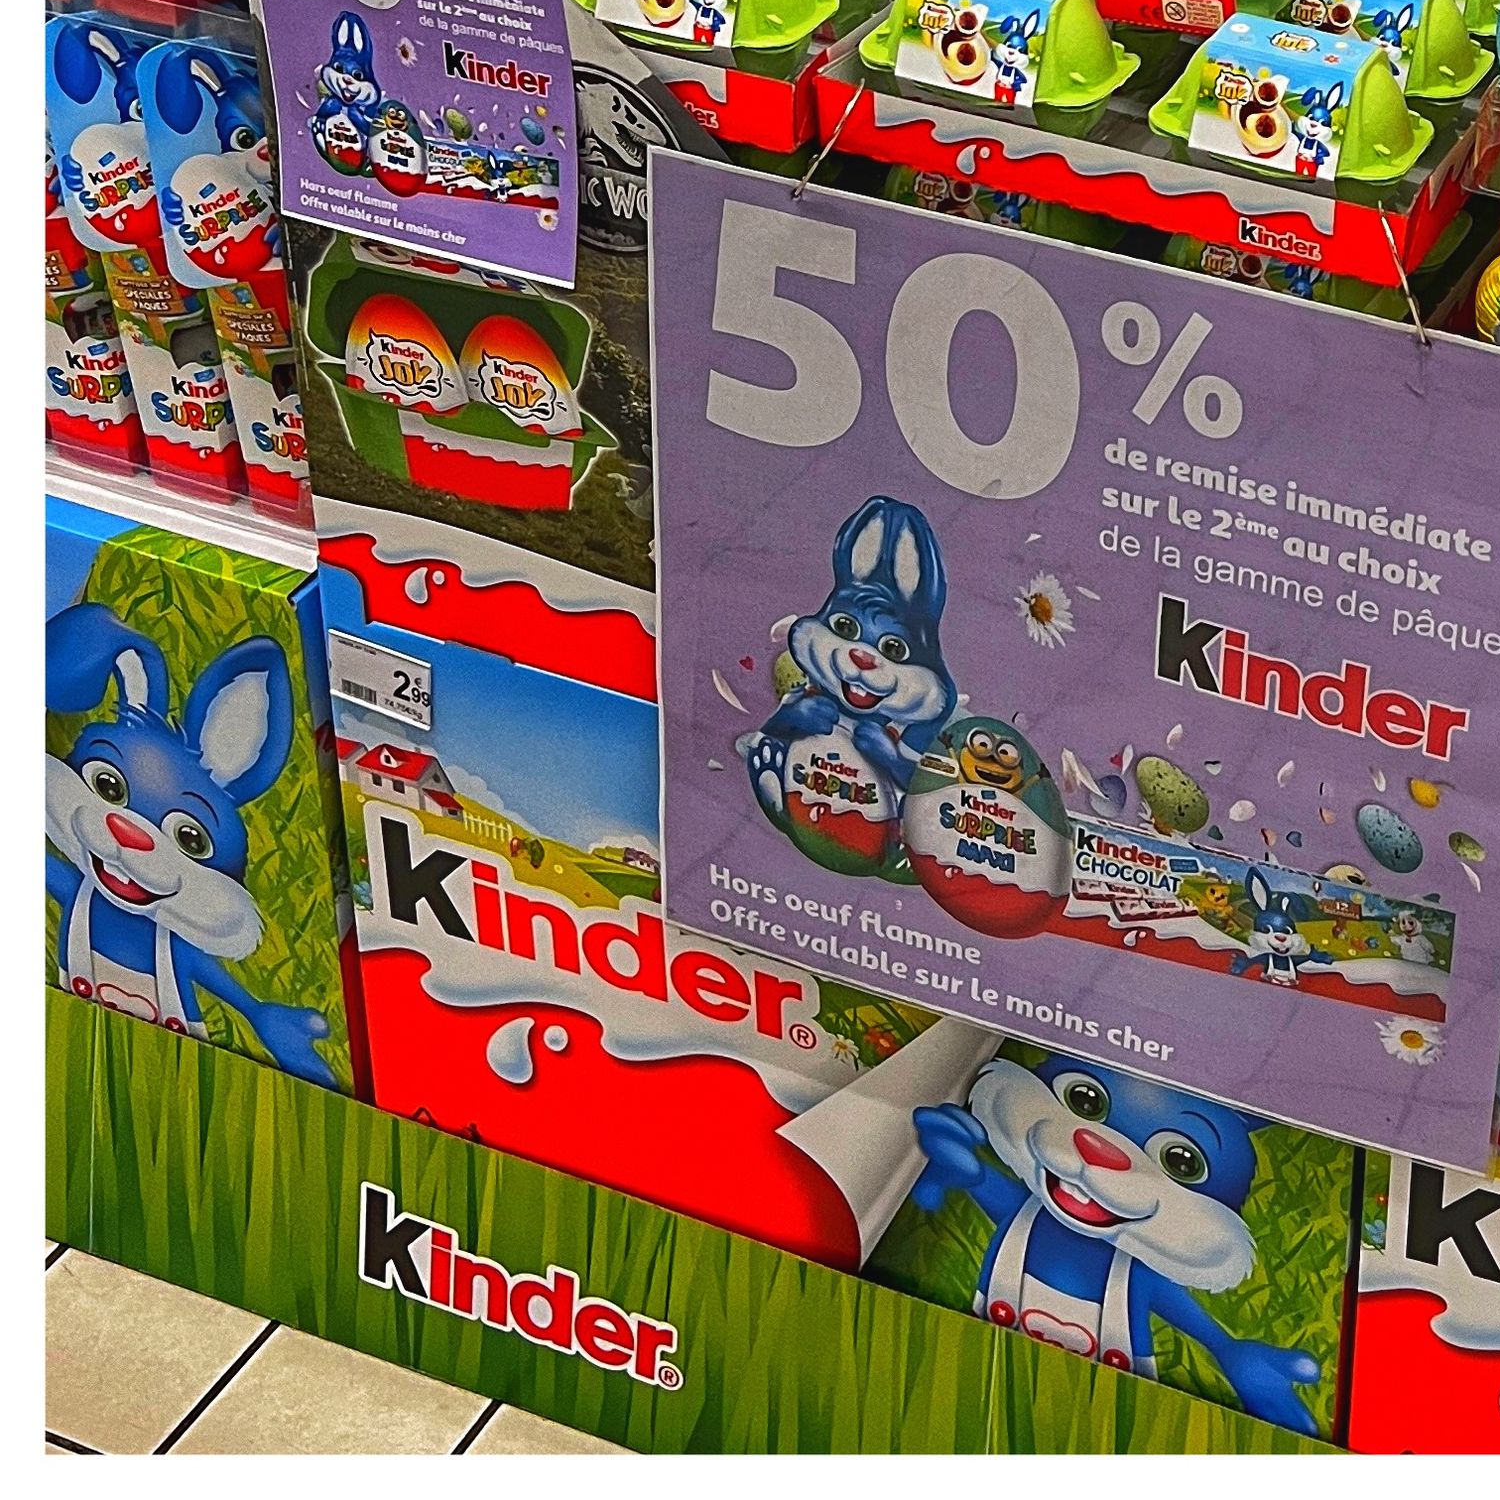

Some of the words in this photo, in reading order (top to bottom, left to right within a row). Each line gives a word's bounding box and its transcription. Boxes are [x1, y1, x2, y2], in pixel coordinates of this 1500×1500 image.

[444, 41, 549, 96] Kinder
[179, 189, 268, 246] SURPRISE
[189, 187, 240, 218] Kinder
[1241, 219, 1318, 259] Kinder
[381, 339, 424, 361] Kinder
[494, 363, 538, 383] Kinder
[707, 199, 1242, 500] 50%
[1103, 488, 1159, 517] sur
[1168, 496, 1202, 530] le
[1211, 510, 1278, 539] 2ème
[1284, 538, 1329, 565] au
[1339, 548, 1441, 594] choix
[1105, 438, 1147, 471] de
[1157, 457, 1277, 505] remise
[1287, 482, 1490, 561] immédiate
[1099, 526, 1140, 557] de
[1154, 537, 1181, 569] la
[1195, 556, 1323, 607] gamme
[1337, 591, 1379, 622] de
[1158, 598, 1466, 756] Kinder
[380, 816, 803, 1040] Kinder
[711, 864, 777, 904] Hors
[785, 895, 852, 926] oeuf
[860, 911, 980, 964] flamme
[711, 900, 785, 941] Offre
[794, 931, 907, 978] valable
[915, 969, 963, 994] sur
[972, 978, 998, 1006] le
[1007, 996, 1099, 1037] moins
[1108, 1026, 1174, 1061] cher
[367, 1187, 673, 1380] Kinder
